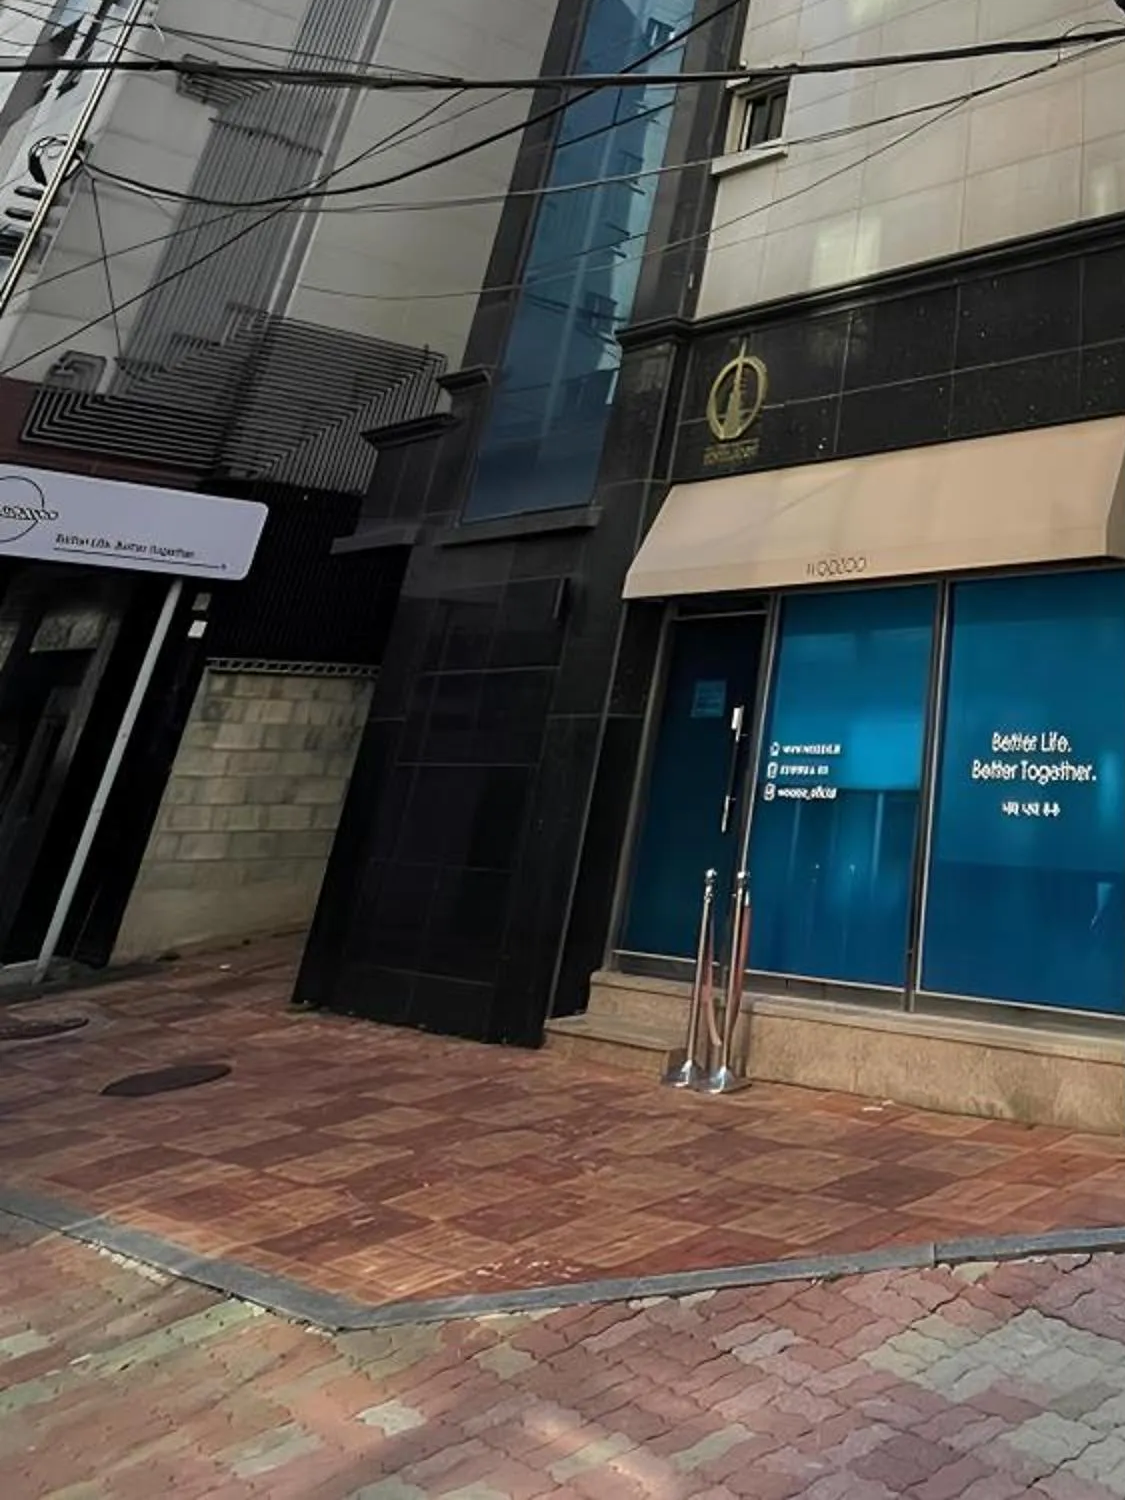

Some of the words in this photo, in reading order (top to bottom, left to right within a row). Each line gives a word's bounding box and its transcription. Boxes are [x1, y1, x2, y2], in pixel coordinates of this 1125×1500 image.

[991, 731, 1038, 753] Better
[971, 759, 1018, 780] Better
[1021, 759, 1097, 786] Together.
